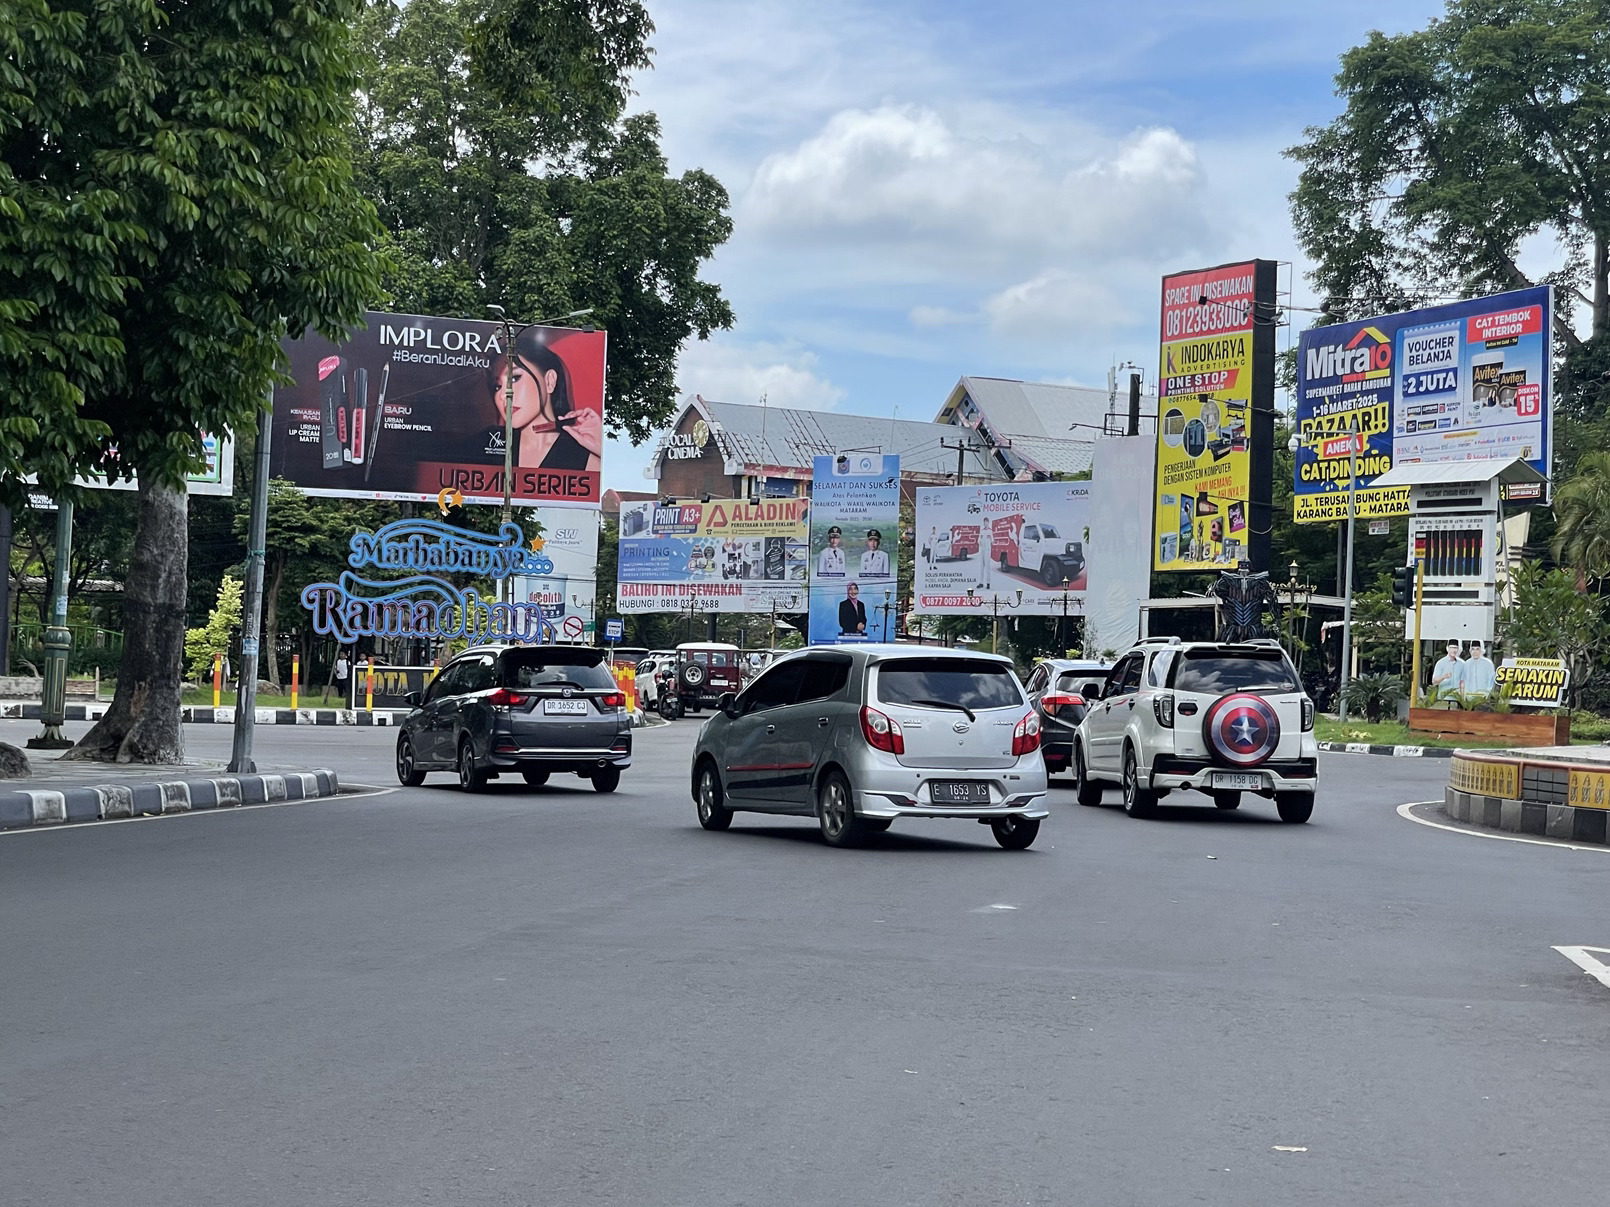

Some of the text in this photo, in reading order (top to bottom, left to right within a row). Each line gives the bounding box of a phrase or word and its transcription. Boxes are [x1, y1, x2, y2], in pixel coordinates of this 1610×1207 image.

[1165, 286, 1189, 307] SPACE
[1204, 275, 1253, 300] DISEWAKAN
[1475, 310, 1531, 329] CAT TEMBOK
[1482, 323, 1523, 338] INTERIOR
[379, 324, 502, 354] IMPLORA
[1181, 337, 1245, 365] INDOKARYA
[1408, 349, 1453, 367] BELANJA
[392, 349, 490, 369] #BeraniJadiAku
[1180, 359, 1246, 373] ADVERTISING
[1168, 371, 1228, 389] ONE STOP
[1474, 363, 1501, 382] Avitex
[1500, 371, 1525, 385] Avitex
[1168, 383, 1224, 396] PRINTING SOLUTION
[1407, 371, 1457, 394] 2 JUTA
[1305, 384, 1342, 399] SUPERMARKET
[1517, 386, 1539, 395] DISKON
[384, 406, 412, 415] BARU
[1312, 393, 1378, 417] 1-16 MARET 2025
[384, 423, 432, 432] EYEBROW PENCIL
[667, 446, 704, 460] CINEMA
[1325, 439, 1360, 455] ANEKA
[1163, 459, 1196, 475] PENGERJAAN
[1163, 462, 1232, 486] DENGAN SISTEM KOMPUTER
[1301, 456, 1391, 481] CAT DINDING
[439, 468, 591, 497] URBAN SERIES
[814, 480, 898, 490] SELAMAT DAN SUKSES
[1208, 476, 1232, 489] MEMANG
[984, 491, 1020, 502] TOYOTA
[1300, 498, 1312, 508] JL.
[1355, 492, 1381, 504] BUNG
[731, 502, 797, 522] ALADIN
[982, 502, 1041, 513] MOBILE SERVICE
[1296, 508, 1333, 519] KARANG
[1335, 505, 1361, 517] BAU
[654, 508, 680, 525] PRINT
[682, 508, 701, 523] A3+
[555, 528, 579, 540] SW
[349, 530, 492, 575] Marhaban
[623, 547, 670, 557] PRINTING
[529, 591, 563, 603] decolith
[621, 583, 743, 597] BALIHO INI DISEWAKAN
[619, 599, 655, 609] HUBUNGI
[661, 599, 678, 608] 0818
[700, 599, 719, 609] 9688
[926, 597, 943, 606] 0877
[943, 597, 961, 606] 0097
[301, 582, 557, 647] Ramadhan
[1531, 660, 1560, 668] MATARAM
[1496, 666, 1565, 685] SEMAKIN
[1501, 683, 1558, 699] ARUM
[547, 701, 586, 710] DR 1652 CJ
[1215, 774, 1224, 783] DR
[1229, 775, 1246, 784] 1158
[934, 784, 987, 795] E 1653 YS
